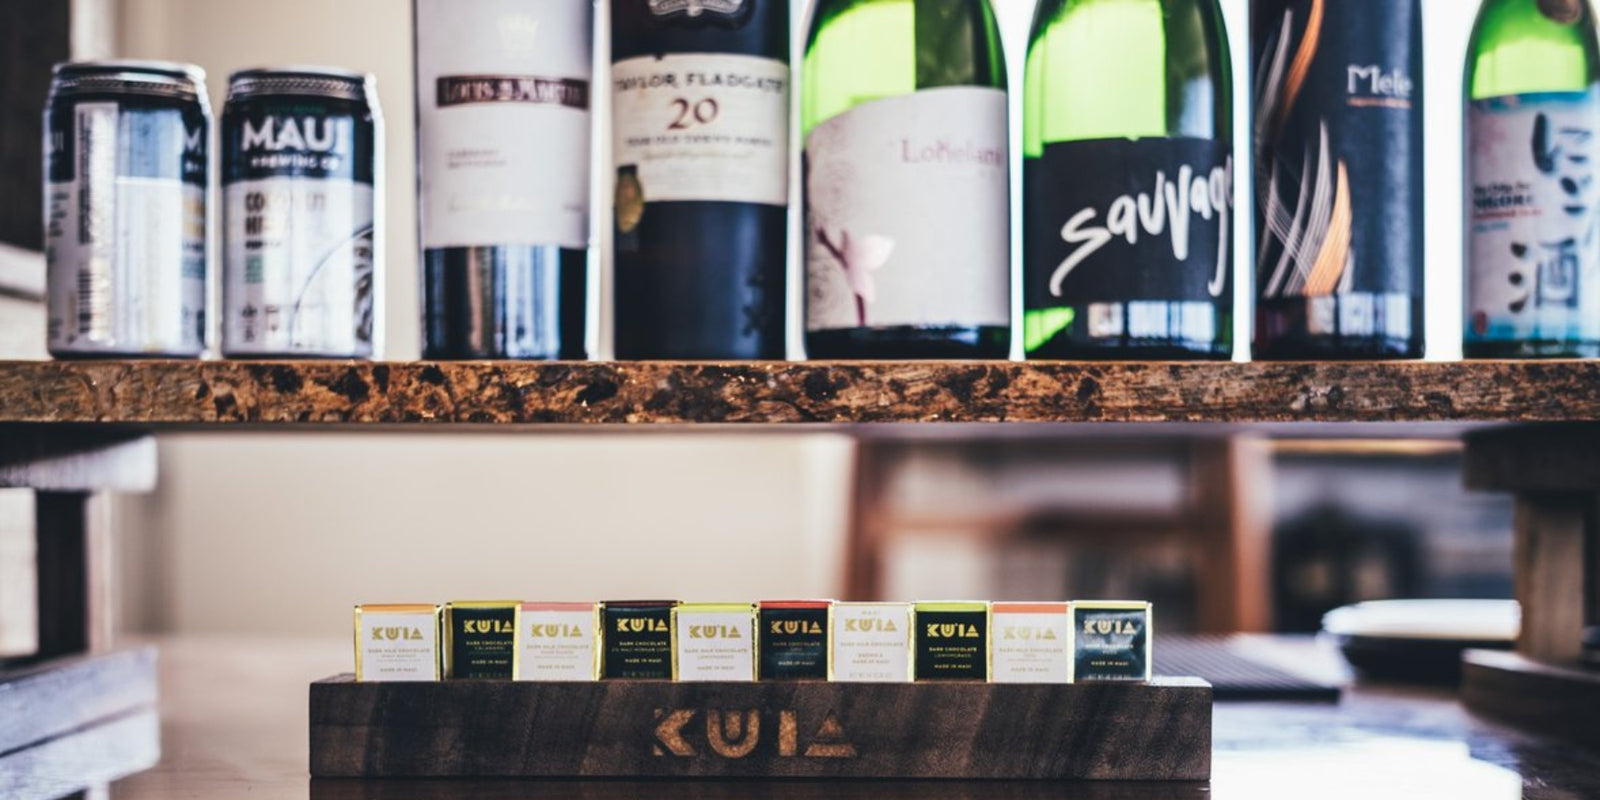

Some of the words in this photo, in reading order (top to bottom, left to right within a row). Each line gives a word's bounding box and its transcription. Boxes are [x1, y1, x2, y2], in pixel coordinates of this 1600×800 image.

[1347, 64, 1413, 96] Mele
[666, 95, 720, 131] 20
[240, 113, 350, 152] MAUI
